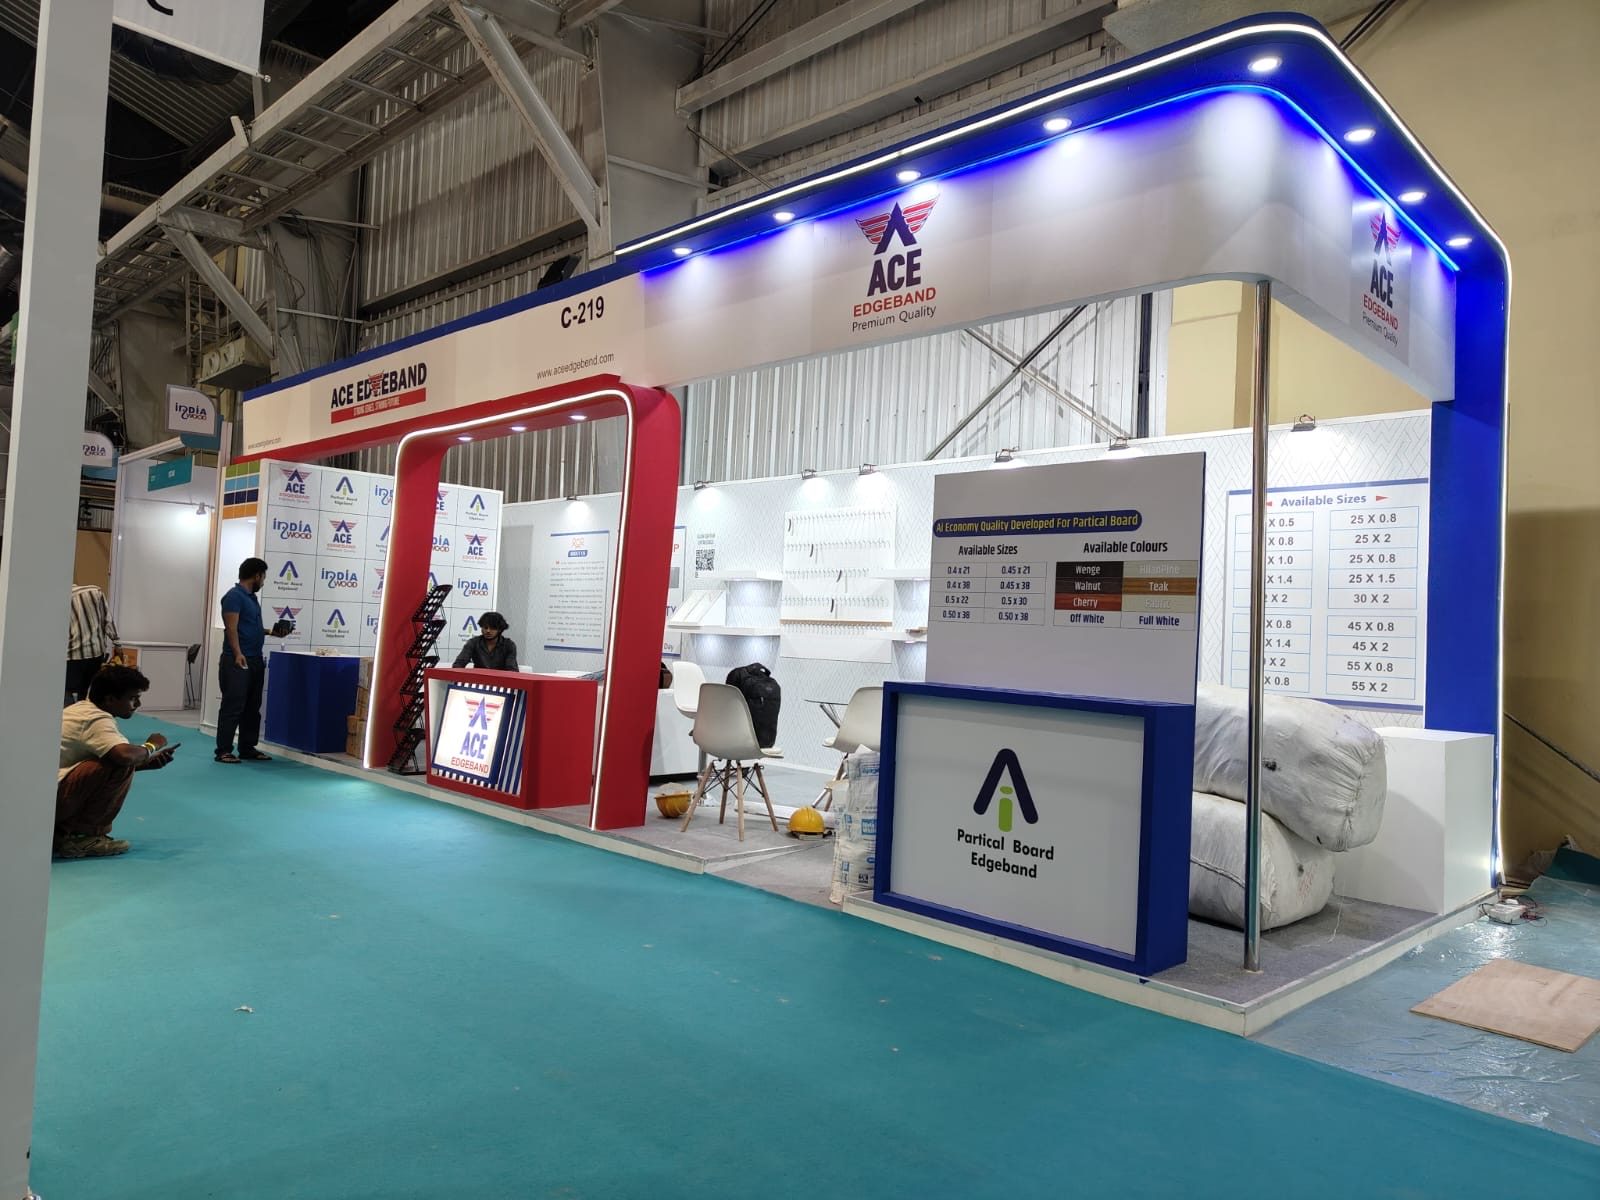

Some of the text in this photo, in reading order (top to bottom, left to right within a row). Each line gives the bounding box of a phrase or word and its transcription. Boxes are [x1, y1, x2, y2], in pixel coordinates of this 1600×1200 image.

[867, 248, 922, 297] ACE
[1370, 259, 1394, 308] ACE
[853, 287, 936, 317] EDGEBAND
[561, 296, 604, 328] C-219
[1363, 294, 1398, 330] EDGEBAND
[852, 305, 937, 332] Premium Quality
[1362, 311, 1398, 347] Premium Quality
[331, 384, 353, 408] ACE
[285, 483, 305, 494] ACE
[1280, 494, 1367, 507] Available Sizes
[945, 522, 979, 533] Economy
[980, 520, 1009, 532] Quality
[1011, 518, 1054, 530] Developed
[1057, 518, 1070, 528] For
[1073, 515, 1108, 527] Partical
[1110, 514, 1138, 526] Board
[1268, 518, 1294, 527] X 0.5
[1350, 513, 1397, 524] 25 X 0.8
[287, 531, 312, 540] WOOD
[333, 534, 352, 544] ACE
[1355, 534, 1391, 544] 25 X 2
[1268, 537, 1294, 546] X 0.8
[467, 546, 484, 556] ACE
[958, 544, 1018, 556] Available Sizes
[1083, 541, 1168, 553] Available Colours
[1267, 556, 1293, 564] X 1.0
[1349, 554, 1396, 564] 25 X 0.8
[947, 566, 957, 574] 0.4
[962, 566, 970, 574] 21
[1001, 566, 1016, 574] 0.45
[1022, 566, 1030, 574] 21
[1076, 566, 1101, 576] Wenge
[1267, 575, 1292, 584] X 1.4
[1349, 574, 1396, 583] 25 X 1.5
[335, 580, 358, 588] WOOD
[1074, 581, 1101, 591] Walnut
[1149, 582, 1168, 591] Teak
[946, 596, 955, 604] 0.5
[960, 596, 969, 604] 22
[1073, 598, 1098, 608] Cherry
[1272, 594, 1278, 602] X
[1282, 594, 1288, 602] 2
[1354, 594, 1390, 603] 30 X 2
[1070, 614, 1104, 624] Off White
[1139, 616, 1179, 626] Full White
[1266, 620, 1292, 629] X 0.8
[1348, 622, 1394, 632] 45 X 0.8
[1266, 639, 1291, 648] X 1.4
[1352, 641, 1389, 652] 45 X 2
[1269, 658, 1276, 666] X
[1280, 658, 1286, 667] 2
[1347, 661, 1394, 672] 55 X 0.8
[1264, 676, 1290, 686] X 0.8
[1352, 681, 1388, 692] 55 X 2
[460, 731, 488, 760] ACE
[451, 756, 489, 773] EDGEBAND
[957, 828, 1054, 860] Partical Board
[971, 852, 1037, 879] Edgeband
